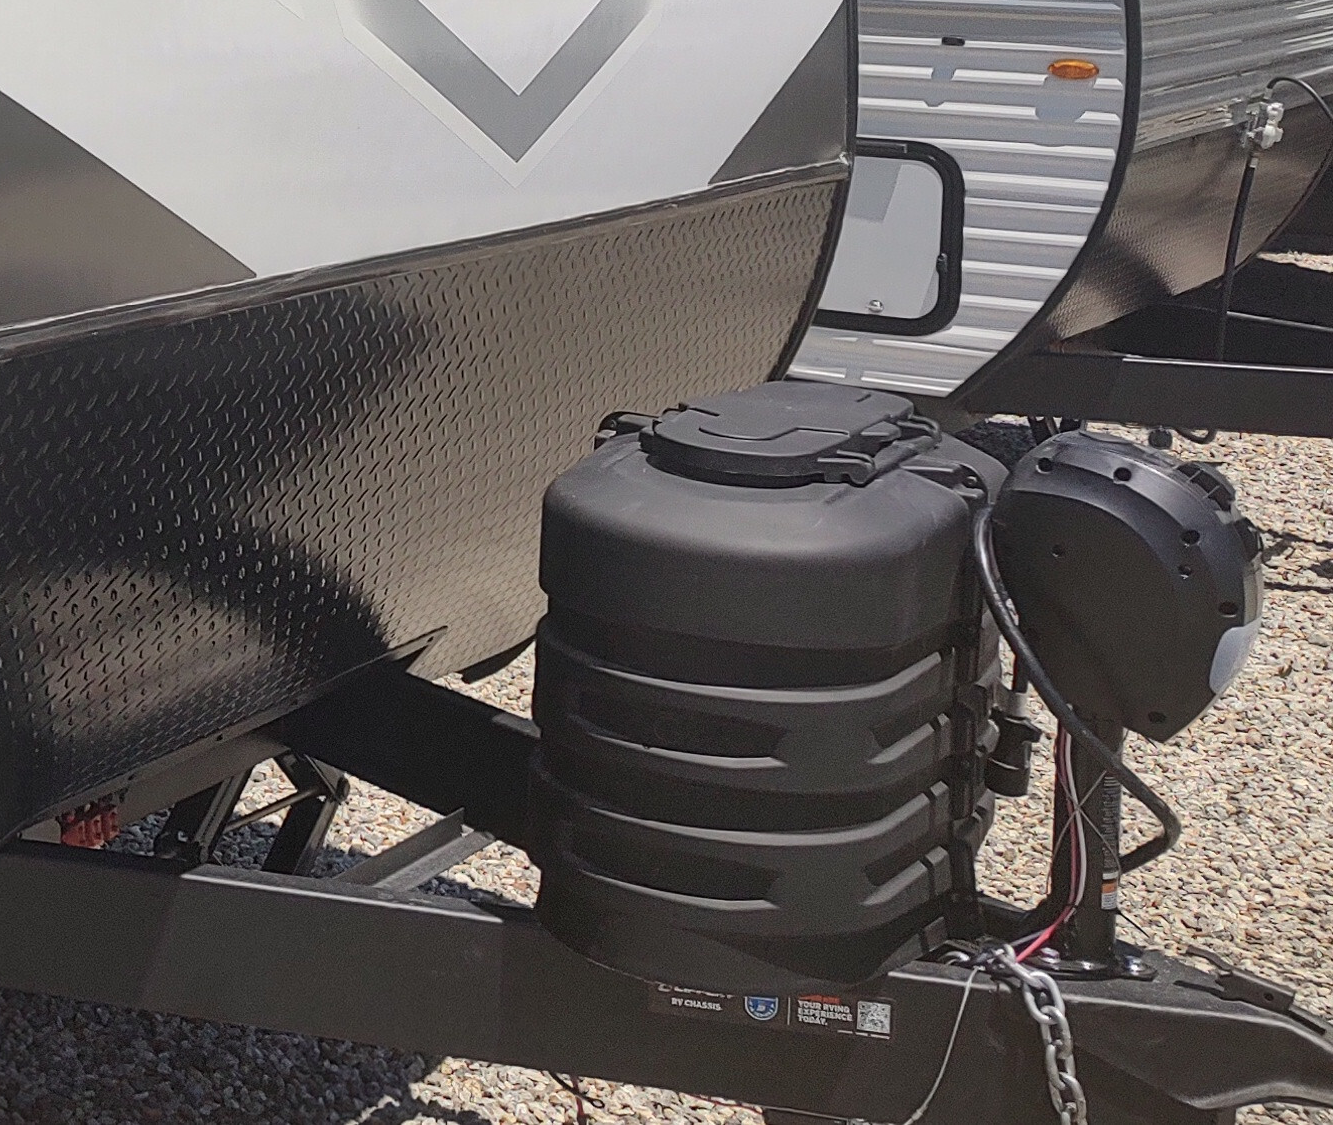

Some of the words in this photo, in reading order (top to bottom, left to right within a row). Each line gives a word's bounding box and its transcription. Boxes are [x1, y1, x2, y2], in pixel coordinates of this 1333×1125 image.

[671, 997, 684, 1007] RV
[797, 1000, 822, 1010] YOUR
[822, 1003, 851, 1014] RVING
[797, 1007, 853, 1022] EXPERIENCE
[797, 1014, 828, 1026] TODAY.
